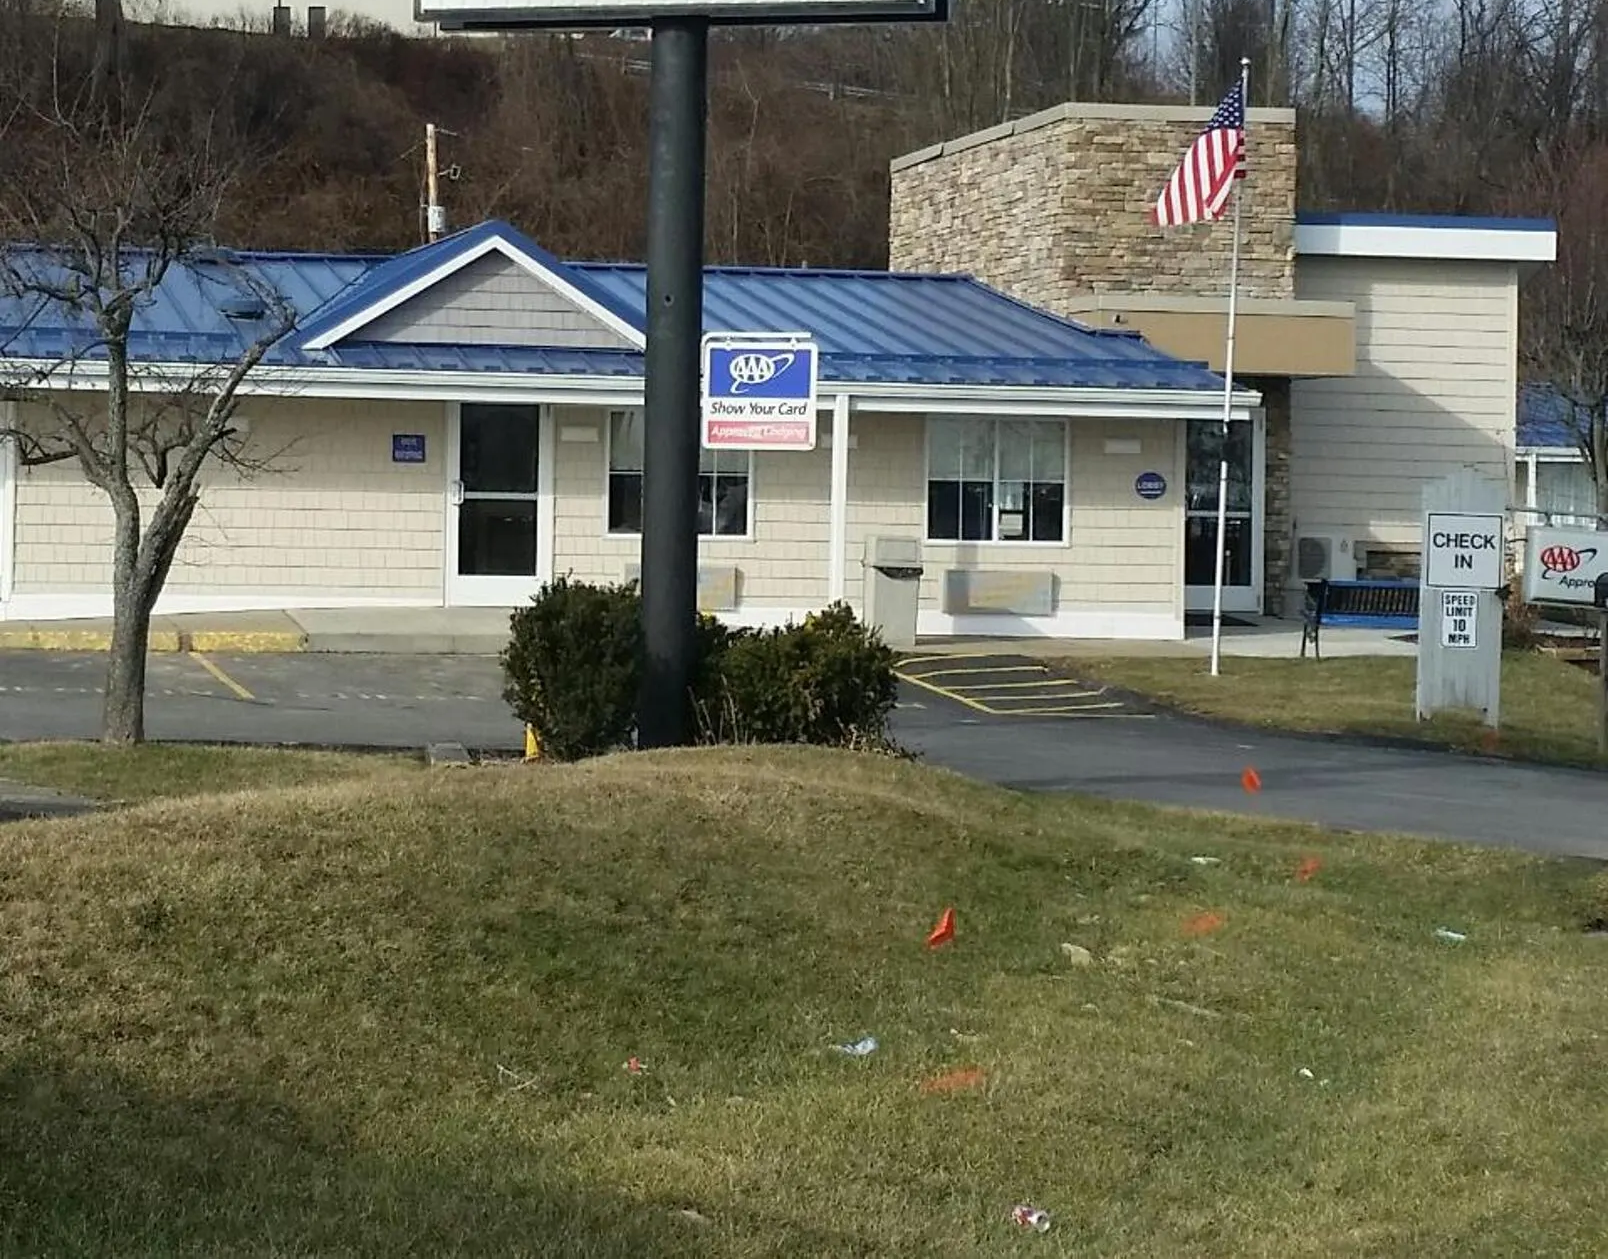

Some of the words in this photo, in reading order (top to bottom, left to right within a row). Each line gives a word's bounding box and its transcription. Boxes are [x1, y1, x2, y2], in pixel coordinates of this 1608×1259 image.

[731, 354, 774, 383] AAA
[710, 401, 746, 415] Show
[749, 402, 777, 416] Your
[778, 402, 808, 416] Card
[1432, 531, 1496, 550] CHECK
[1454, 554, 1473, 570] IN
[1542, 546, 1580, 573] AAA
[1559, 575, 1597, 590] Appro
[1445, 594, 1476, 606] SPEED
[1446, 606, 1473, 617] LIMIT
[1453, 619, 1466, 632] 10
[1448, 633, 1470, 644] MPH
